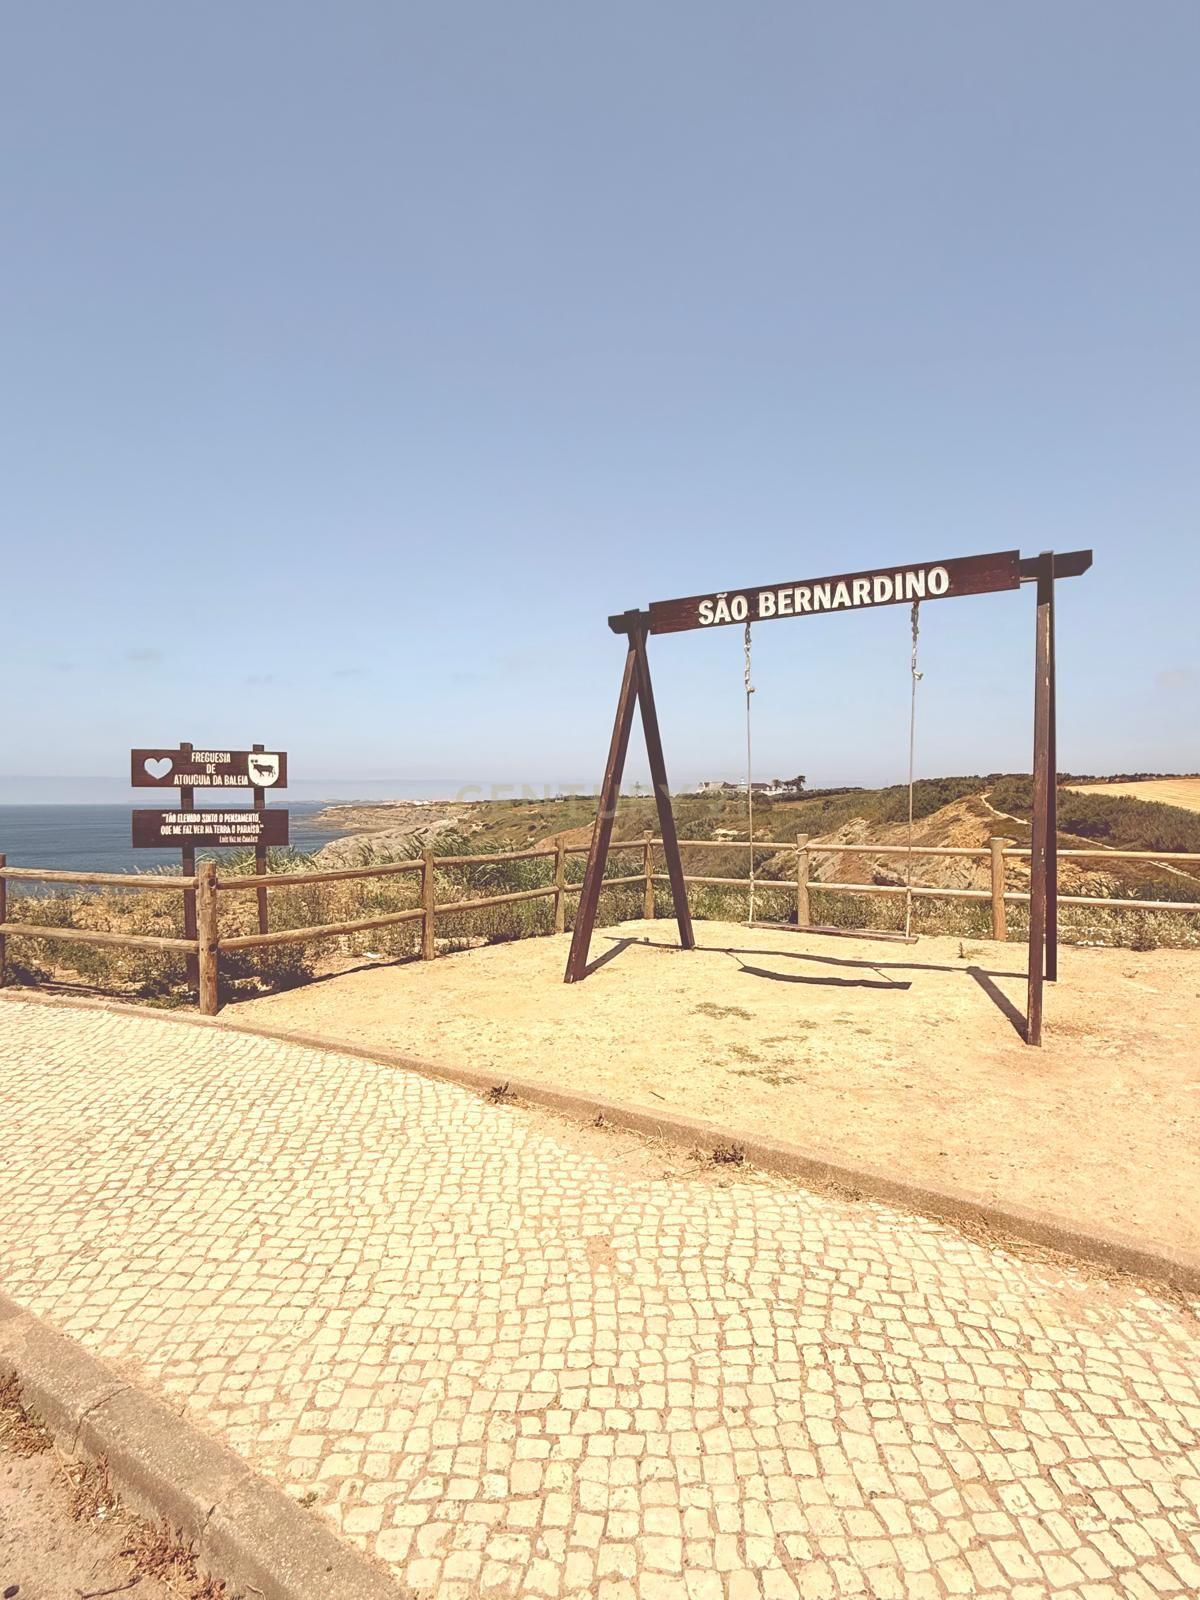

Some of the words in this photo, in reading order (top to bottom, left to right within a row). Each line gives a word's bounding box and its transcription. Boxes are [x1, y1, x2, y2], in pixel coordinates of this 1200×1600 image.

[698, 592, 748, 625] SÃO
[758, 566, 949, 618] BERNARDINO
[191, 752, 231, 763] FREGUESIA
[206, 764, 216, 774] DE
[173, 774, 210, 785] ATOUGUIA
[213, 775, 222, 785] DA
[224, 775, 248, 786] BALEIA
[160, 825, 172, 835] QUE
[173, 825, 182, 834] ME
[183, 825, 193, 834] FAZ
[193, 825, 204, 834] VER
